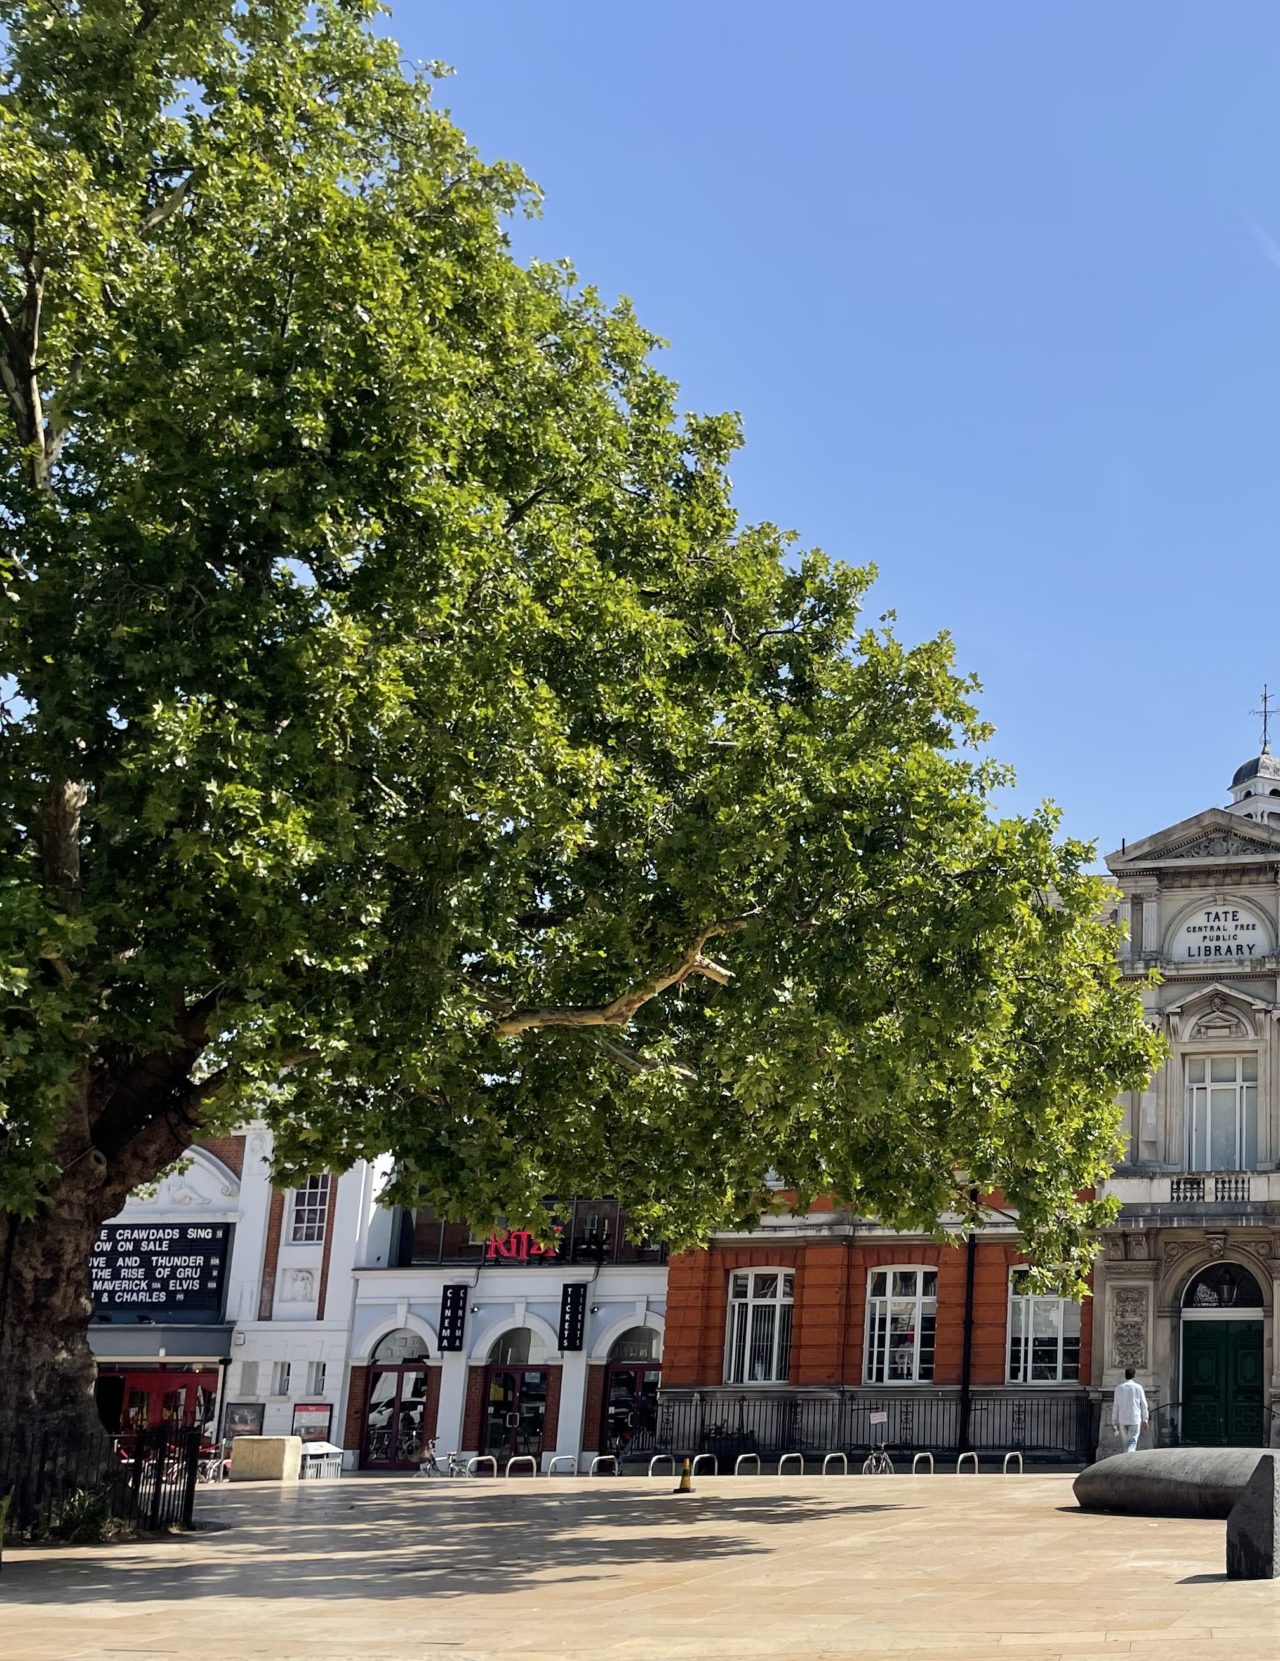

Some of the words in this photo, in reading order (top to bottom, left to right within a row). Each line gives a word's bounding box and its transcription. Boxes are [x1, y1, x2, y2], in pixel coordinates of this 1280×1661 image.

[1204, 911, 1240, 923] TATE
[1186, 925, 1228, 933] CENTRAL
[1234, 923, 1256, 931] FREE
[1202, 934, 1238, 942] PUBLIC
[1188, 944, 1256, 957] LIBRARY
[116, 1228, 180, 1240] CRAWDADS
[187, 1228, 212, 1239] SING
[94, 1241, 112, 1252] OW
[117, 1241, 134, 1252] ON
[140, 1240, 170, 1251] SALE
[486, 1226, 563, 1260] RITZ
[116, 1256, 140, 1267] AND
[152, 1256, 204, 1267] THUNDER
[92, 1268, 112, 1279] THE
[120, 1268, 145, 1279] RISE
[156, 1268, 170, 1278] OF
[176, 1268, 200, 1278] GRU
[92, 1280, 148, 1290] MAVERICK
[169, 1280, 200, 1290] ELVIS
[102, 1292, 108, 1302] &
[115, 1292, 166, 1302] CHARLES
[441, 1289, 453, 1347] CINEMA
[455, 1289, 465, 1347] CINEMA
[563, 1288, 572, 1346] TICKETS
[576, 1288, 584, 1346] TICKETS
